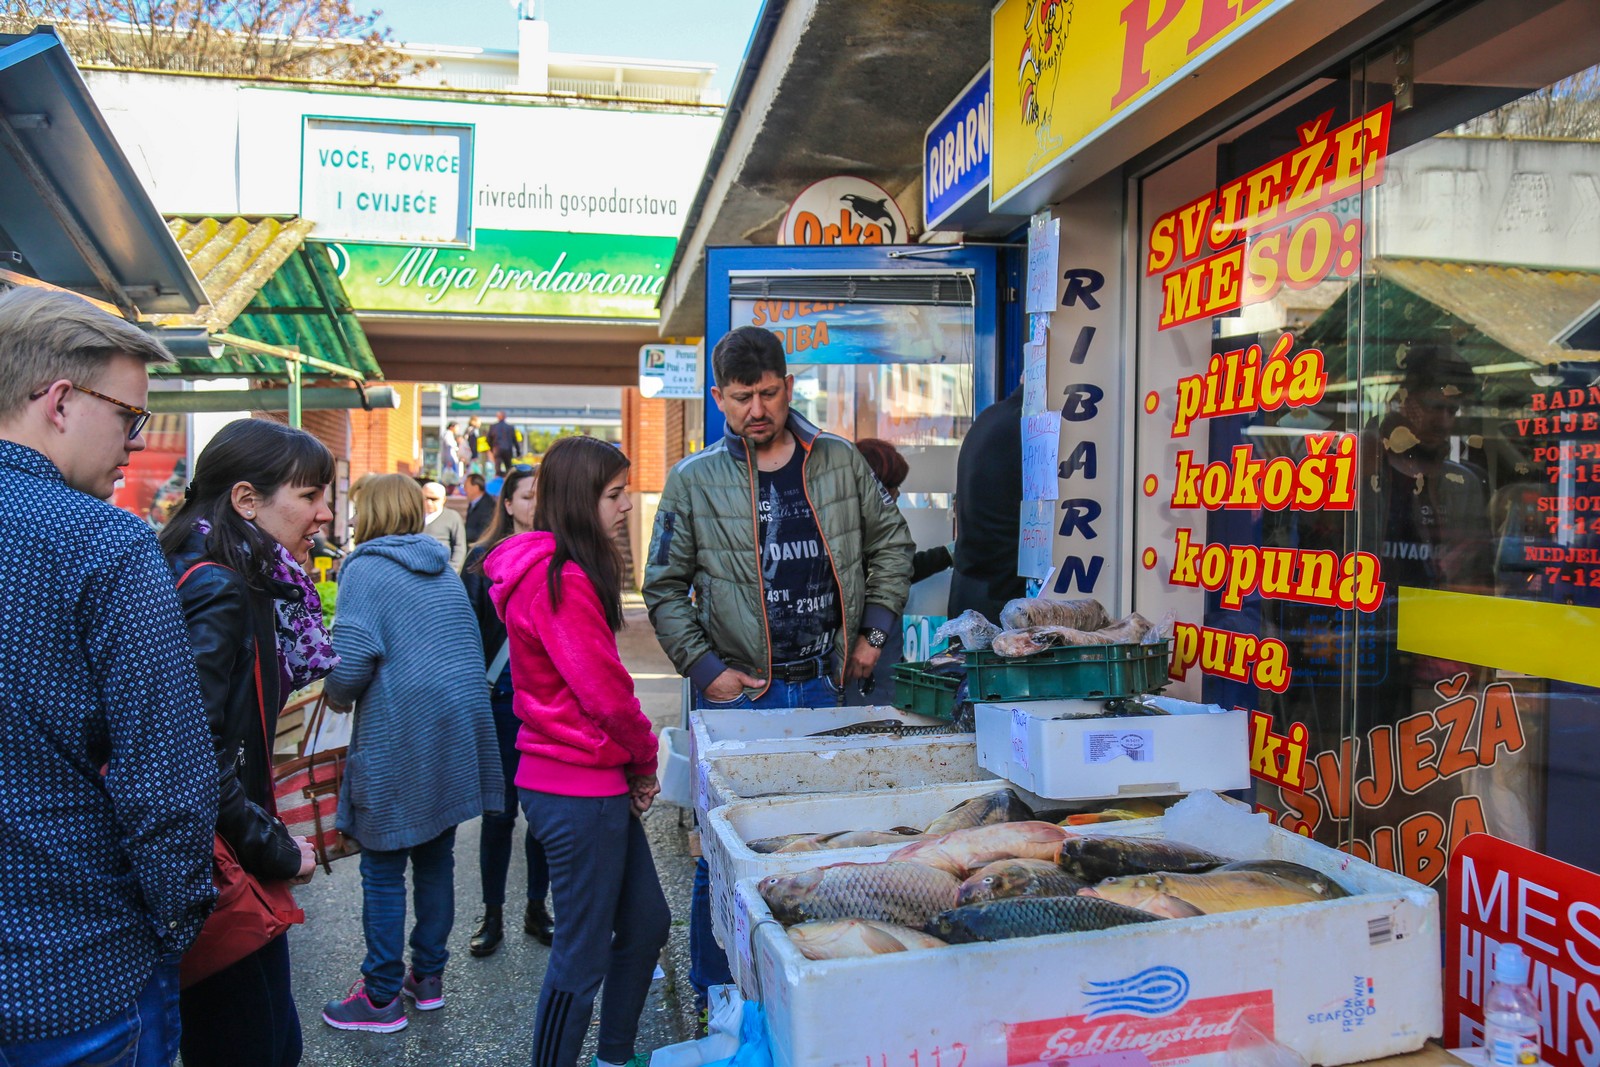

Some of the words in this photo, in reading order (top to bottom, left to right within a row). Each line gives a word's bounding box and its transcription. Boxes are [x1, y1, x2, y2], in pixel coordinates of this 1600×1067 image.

[318, 145, 375, 173] VOĆE,
[387, 149, 459, 173] POVRĆE
[930, 92, 989, 203] RIBARN
[337, 191, 342, 209] I
[356, 190, 437, 214] CVIJEĆE
[479, 183, 552, 209] rivrednih
[560, 188, 677, 217] gospodarstava
[1147, 104, 1388, 274] SVJEŽE
[794, 208, 883, 245] Orka
[376, 247, 479, 304] Moja
[1159, 213, 1361, 328] MESO:
[1172, 335, 1325, 436] pilića
[1516, 412, 1598, 436] VRIJE
[1172, 434, 1355, 508] kokoši
[770, 540, 819, 561] DAVID
[1171, 530, 1382, 609] kopuna
[1170, 624, 1290, 690] pura
[1250, 711, 1307, 793] ki
[1279, 673, 1525, 832] SVJEŽA
[1307, 1006, 1376, 1024] SEAFOOD
[1342, 998, 1353, 1033] FROM
[1354, 975, 1366, 1026] NORWAY
[1040, 1007, 1245, 1061] Sekkingstad
